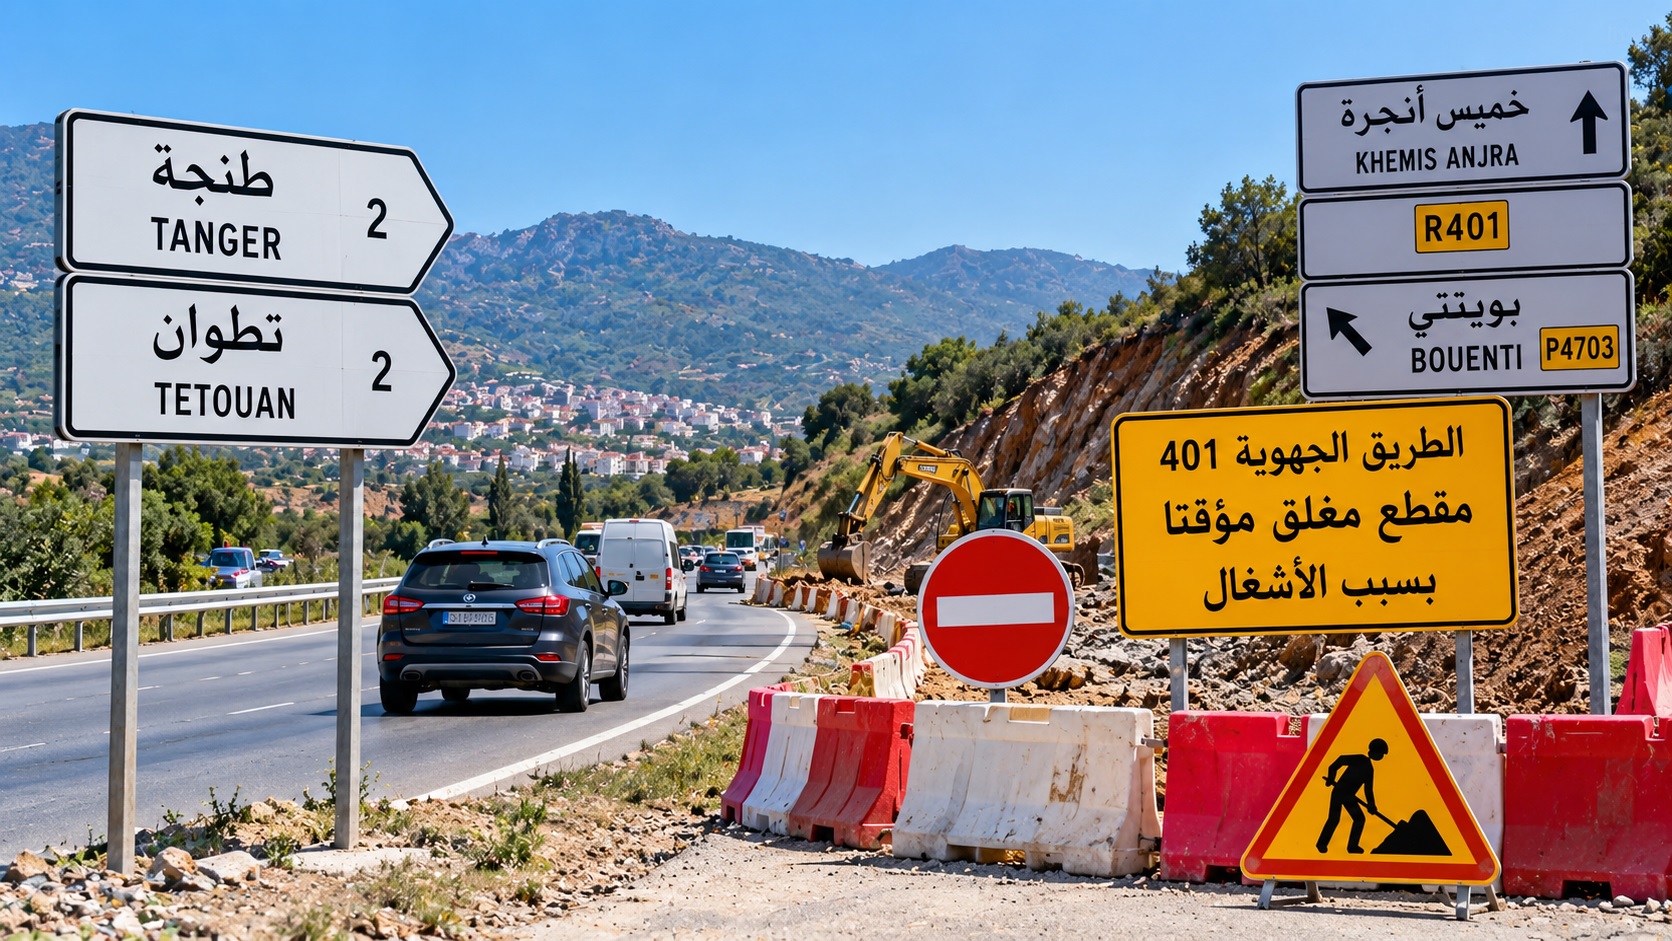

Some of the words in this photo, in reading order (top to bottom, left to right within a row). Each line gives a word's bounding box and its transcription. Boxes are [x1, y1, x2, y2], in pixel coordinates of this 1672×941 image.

[1340, 84, 1426, 137] أنجرة
[1436, 89, 1530, 132] خميس
[151, 142, 275, 206] طنجة
[1356, 147, 1437, 175] KHEMIS
[1446, 143, 1519, 170] ANJRA
[150, 216, 281, 261] TANGER
[367, 197, 387, 240] 2
[1425, 211, 1498, 242] R401
[153, 303, 283, 365] تطوان
[1408, 291, 1521, 339] بويتتي
[1411, 343, 1522, 374] BOUENTI
[1546, 335, 1614, 361] P4703
[371, 350, 392, 392] 2
[154, 381, 295, 420] TETOUAN
[1160, 438, 1217, 471] 401
[1236, 430, 1349, 477] الجهوية
[1362, 424, 1464, 472] الطريق
[1164, 498, 1255, 545] مؤقتا
[1272, 495, 1361, 543] مغلق
[1378, 490, 1473, 544] مقطع
[1203, 556, 1327, 612] الأشغال
[1341, 574, 1436, 607] بسبب
